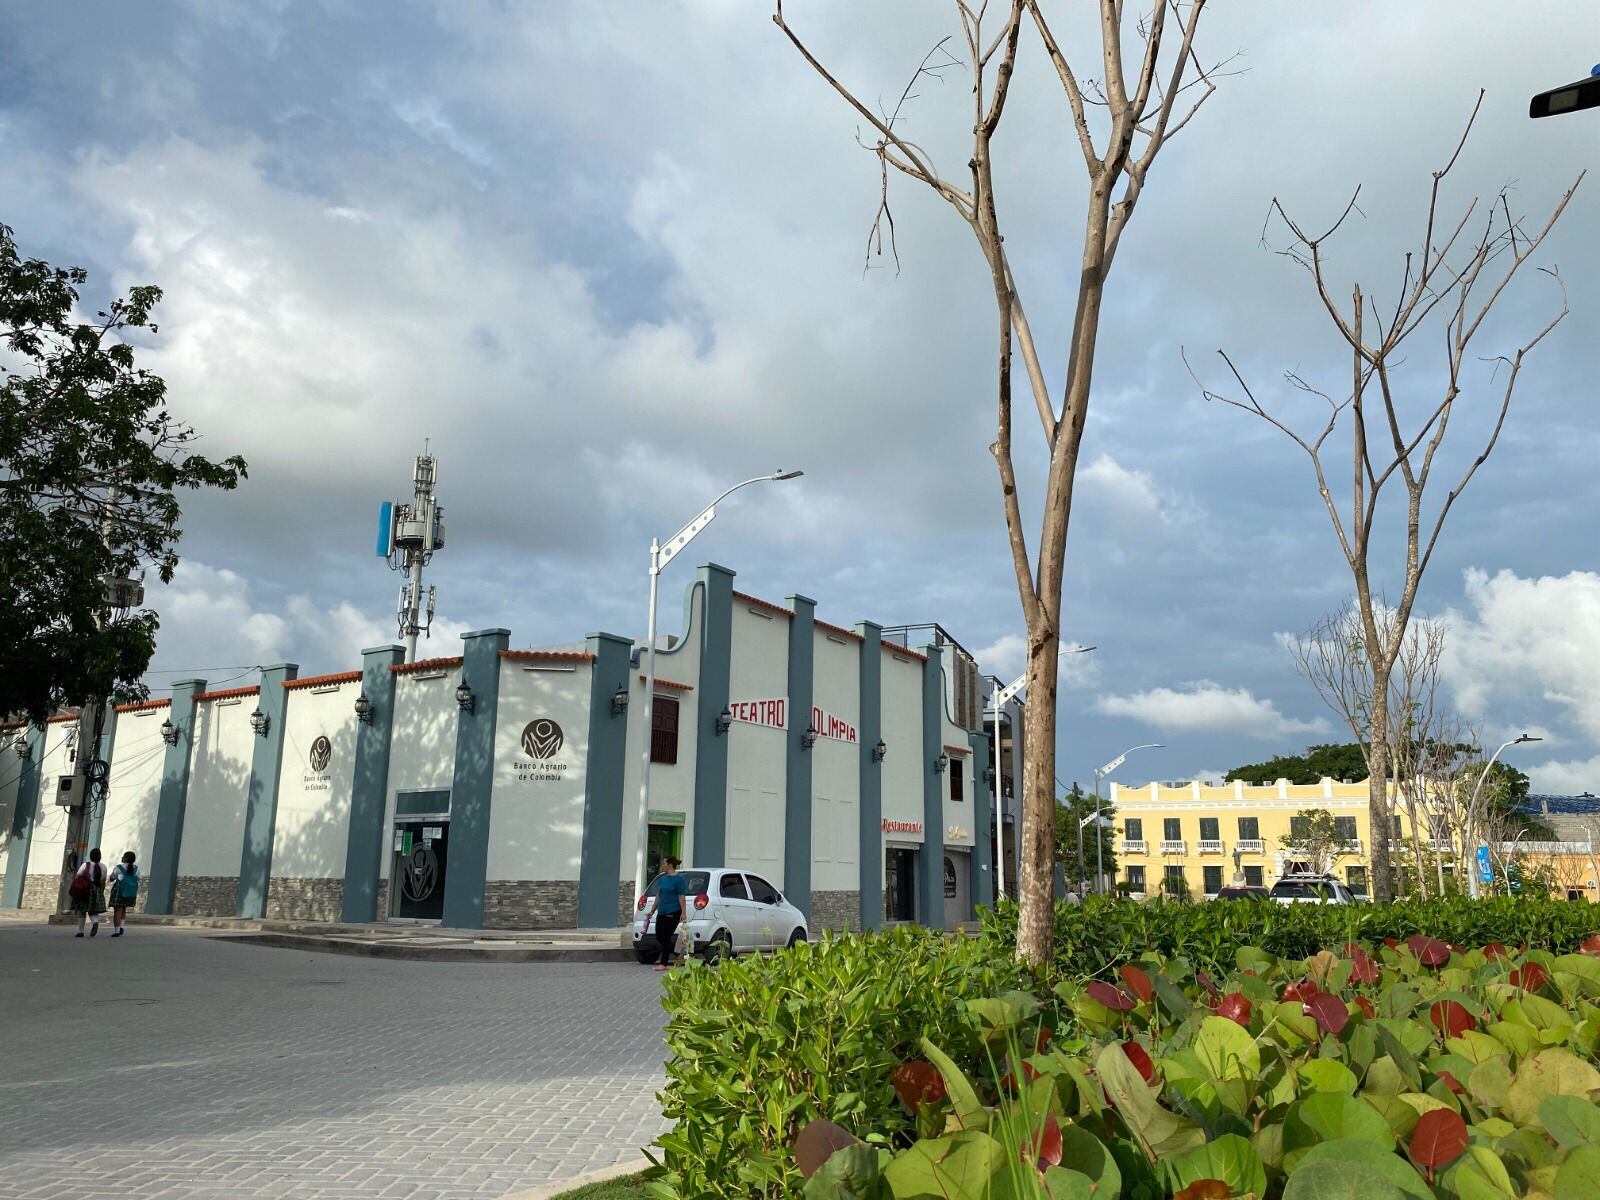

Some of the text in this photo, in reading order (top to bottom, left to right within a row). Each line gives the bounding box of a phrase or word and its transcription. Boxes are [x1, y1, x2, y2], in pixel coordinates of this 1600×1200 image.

[731, 699, 785, 728] TEATRO
[812, 706, 856, 742] OLIMPIA
[513, 762, 567, 772] Banco Agrario
[530, 773, 561, 781] Colombia
[881, 818, 922, 833] Restaurante
